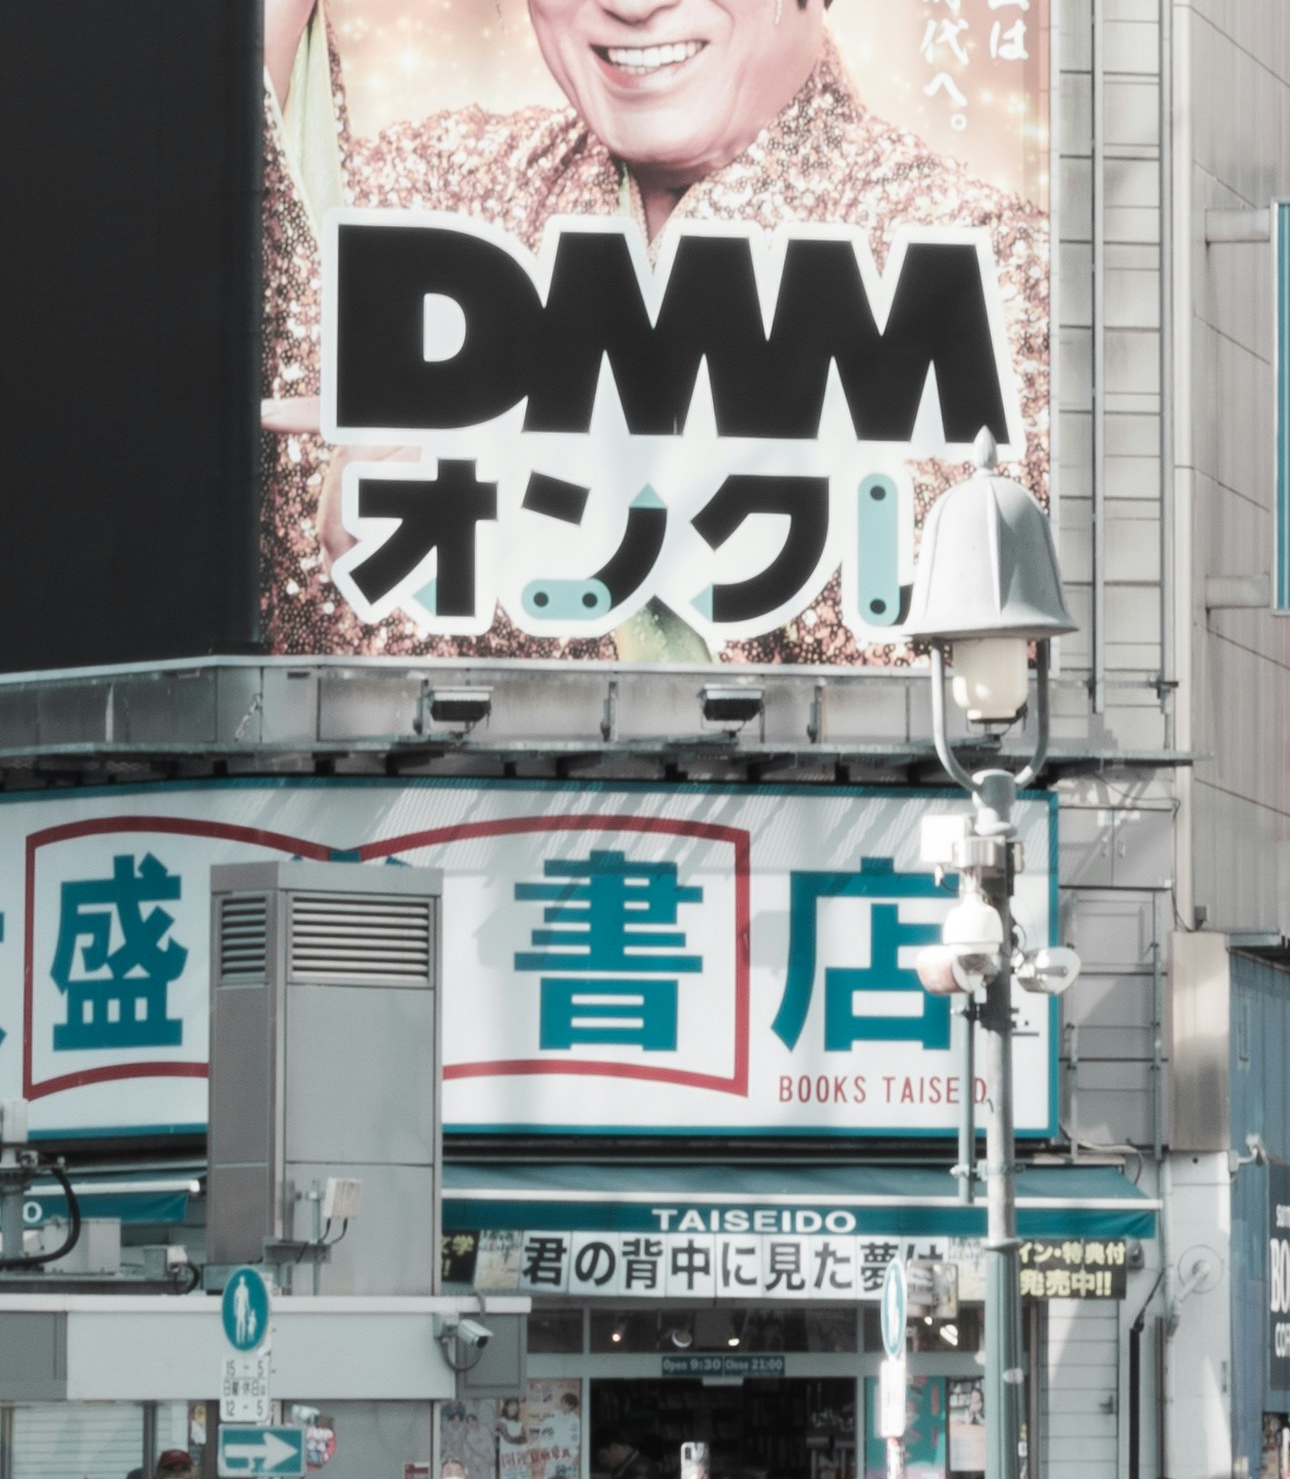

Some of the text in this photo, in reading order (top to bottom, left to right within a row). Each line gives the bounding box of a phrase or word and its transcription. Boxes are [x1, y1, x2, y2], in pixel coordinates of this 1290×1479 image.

[336, 222, 1011, 446] DMM
[779, 1075, 988, 1104] BOOKS TAISED
[652, 1208, 857, 1234] TAISEIDO
